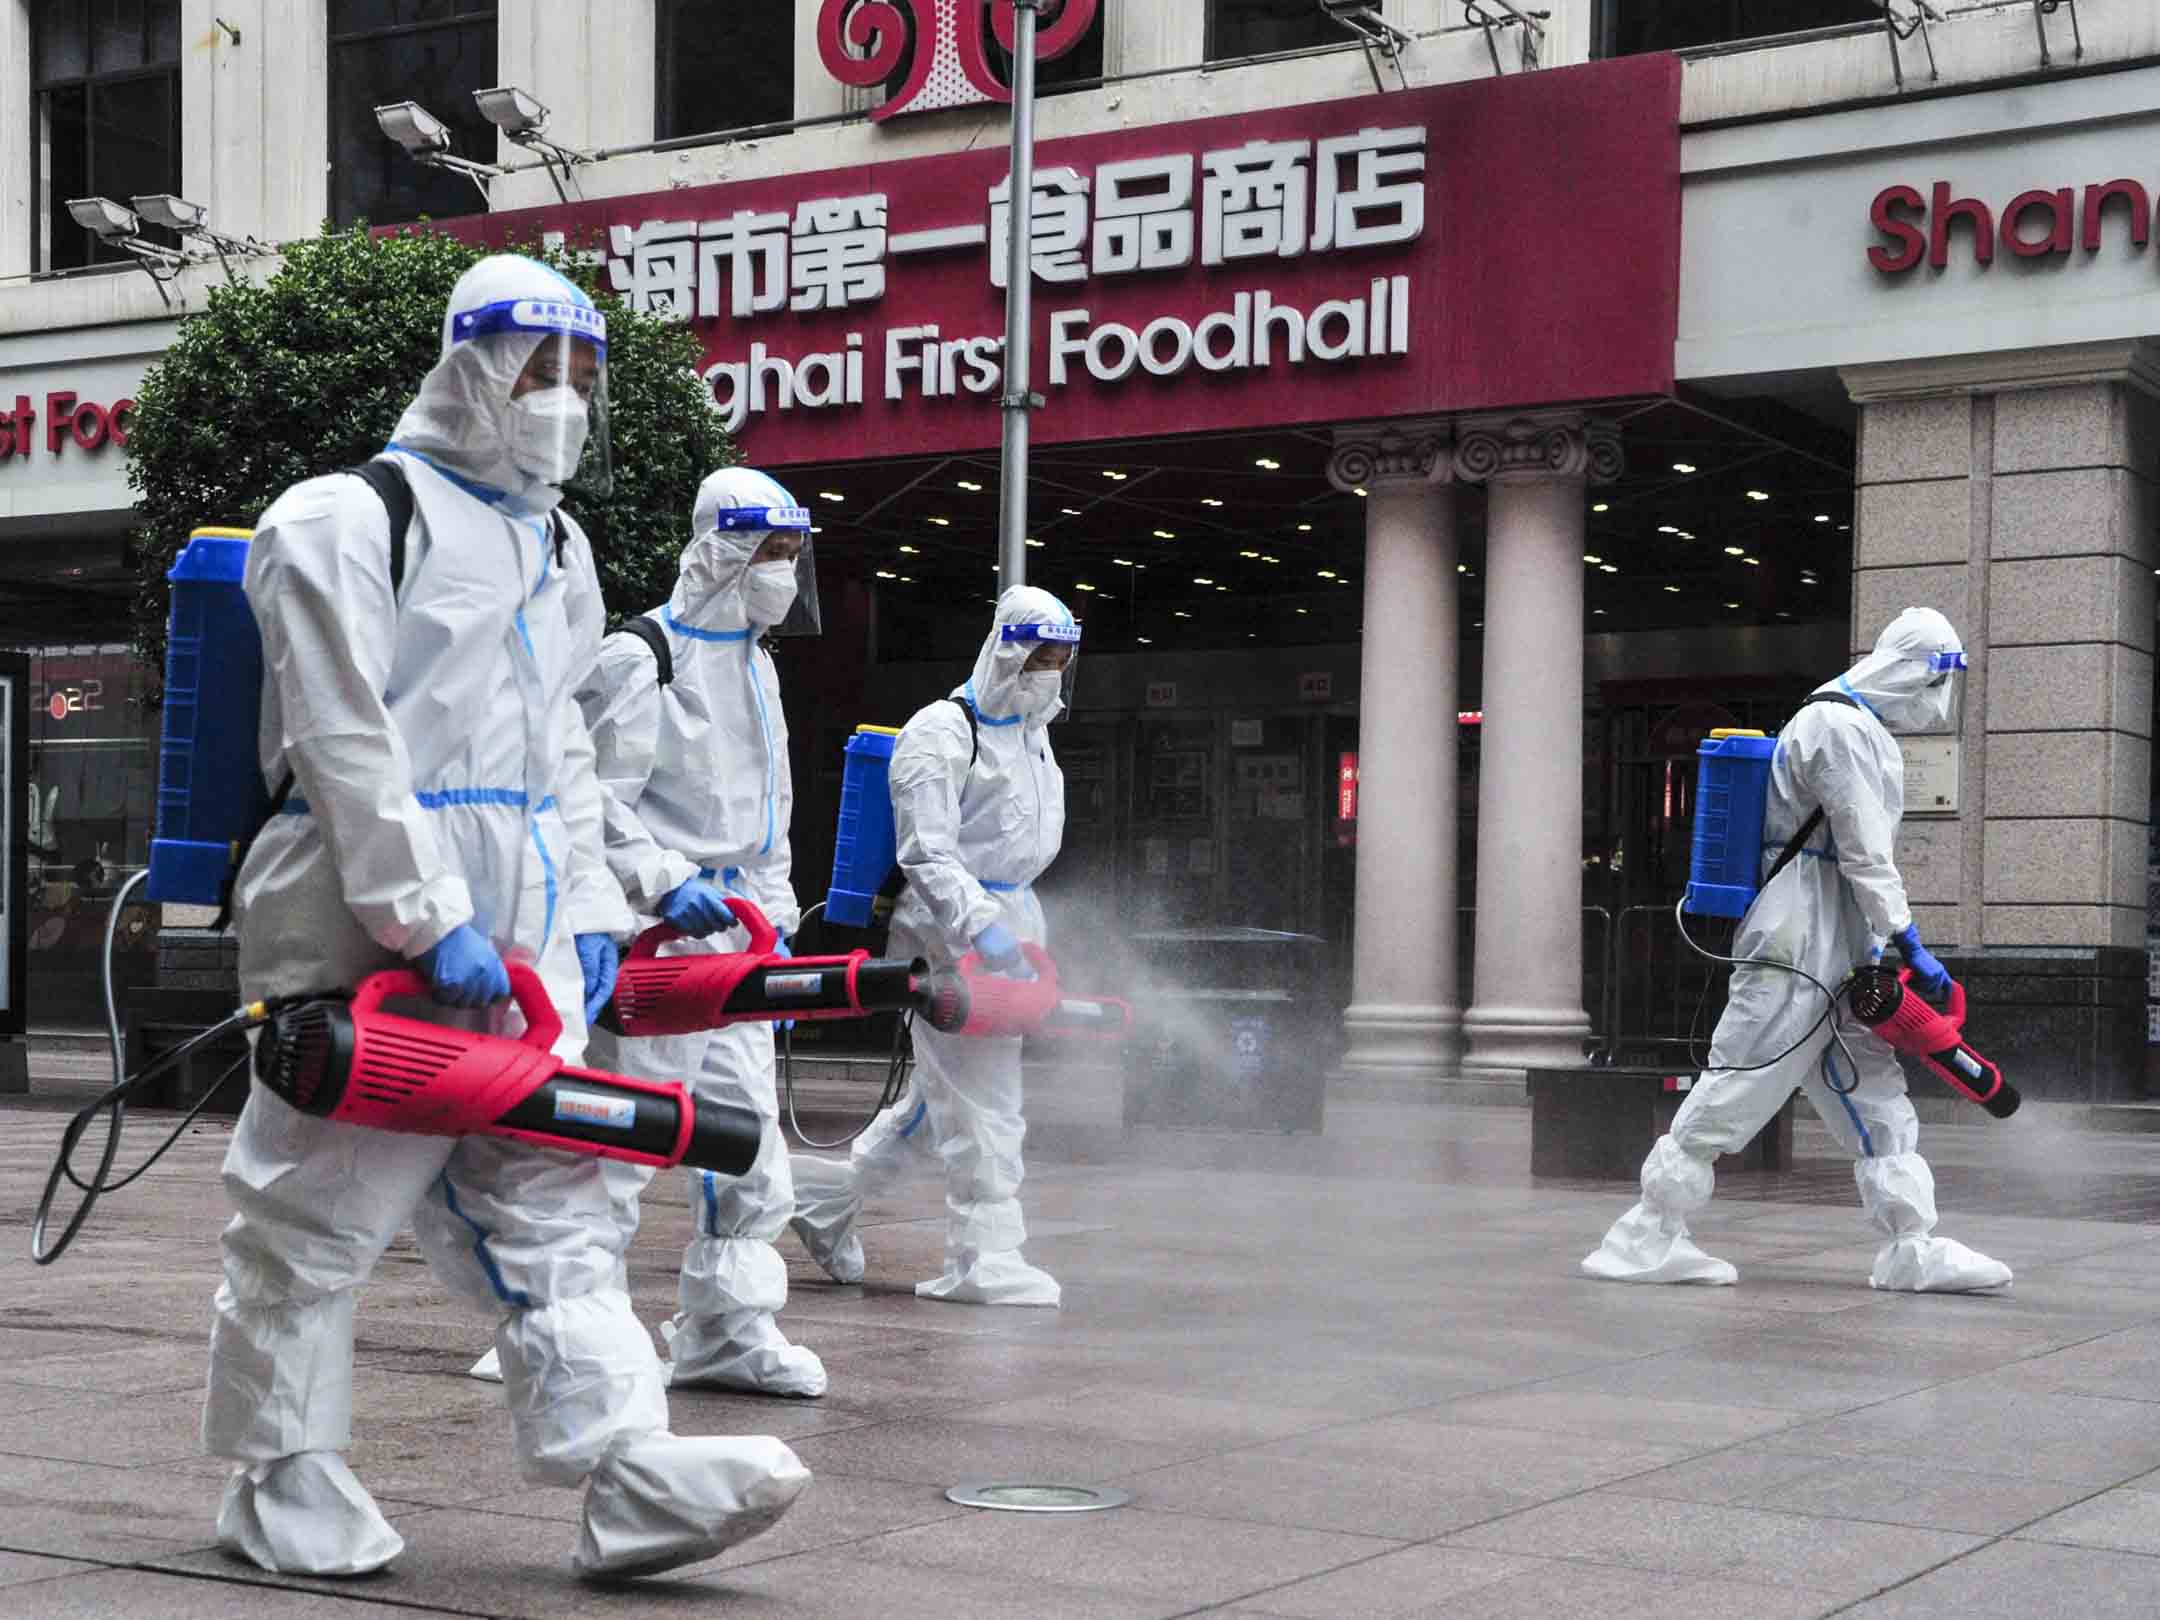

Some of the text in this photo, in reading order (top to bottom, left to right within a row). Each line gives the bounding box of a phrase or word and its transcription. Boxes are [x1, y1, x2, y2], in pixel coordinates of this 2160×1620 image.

[1866, 178, 2160, 273] Shan
[689, 274, 1409, 434] ghai Firs Foodhall
[46, 391, 138, 452] Foo
